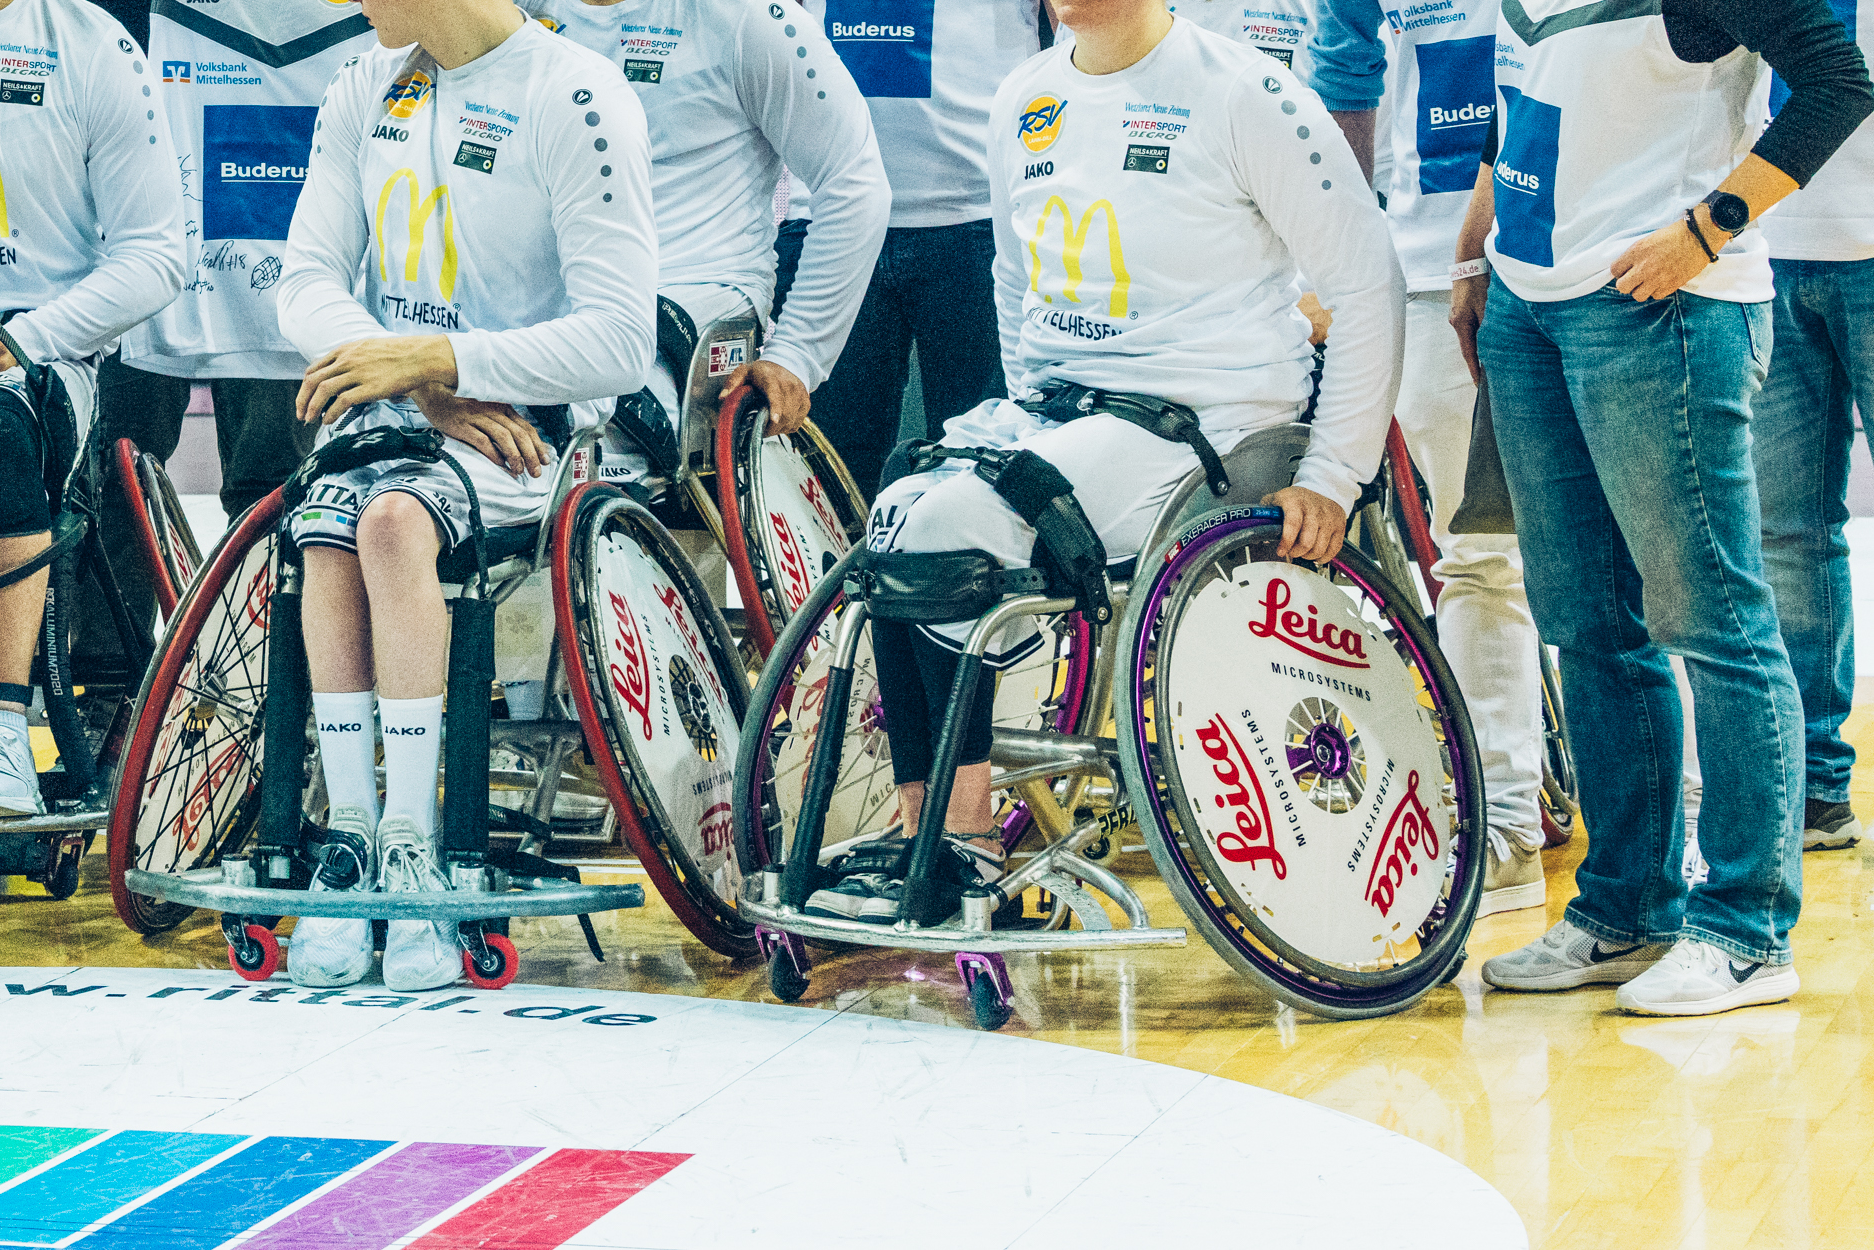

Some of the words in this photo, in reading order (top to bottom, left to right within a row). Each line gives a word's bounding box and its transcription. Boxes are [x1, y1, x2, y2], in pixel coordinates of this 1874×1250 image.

[832, 21, 916, 38] Buderus
[1248, 33, 1299, 45] BEGRO
[1250, 24, 1305, 38] INTERSPORT
[627, 39, 678, 50] INTERSPORT
[0, 66, 50, 77] BEGRO
[1, 57, 57, 73] INTERSPORT
[195, 62, 248, 73] Volksbank
[196, 74, 262, 85] Mittelhessen
[1017, 99, 1069, 139] RSV
[1429, 103, 1496, 125] Bude
[371, 124, 410, 143] JAKO
[466, 117, 514, 138] INTERSPORT
[1127, 130, 1178, 141] BEGRO
[1130, 120, 1188, 134] INTERSPORT
[1024, 160, 1055, 180] JAKO
[1180, 512, 1228, 547] EXERACER
[1229, 508, 1252, 521] PRO
[1247, 577, 1371, 669] Leica
[607, 588, 653, 741] Leica
[640, 612, 671, 736] MICROSYSTEMS
[1270, 661, 1373, 703] MICROSYSTEMS
[319, 722, 363, 733] JAKO
[383, 725, 427, 737] JAKO
[1240, 708, 1306, 848] MICROSYSTEMS
[1195, 712, 1288, 881] Leica
[1347, 758, 1396, 874] MICROSYSTEMS
[1364, 769, 1440, 919] Leica
